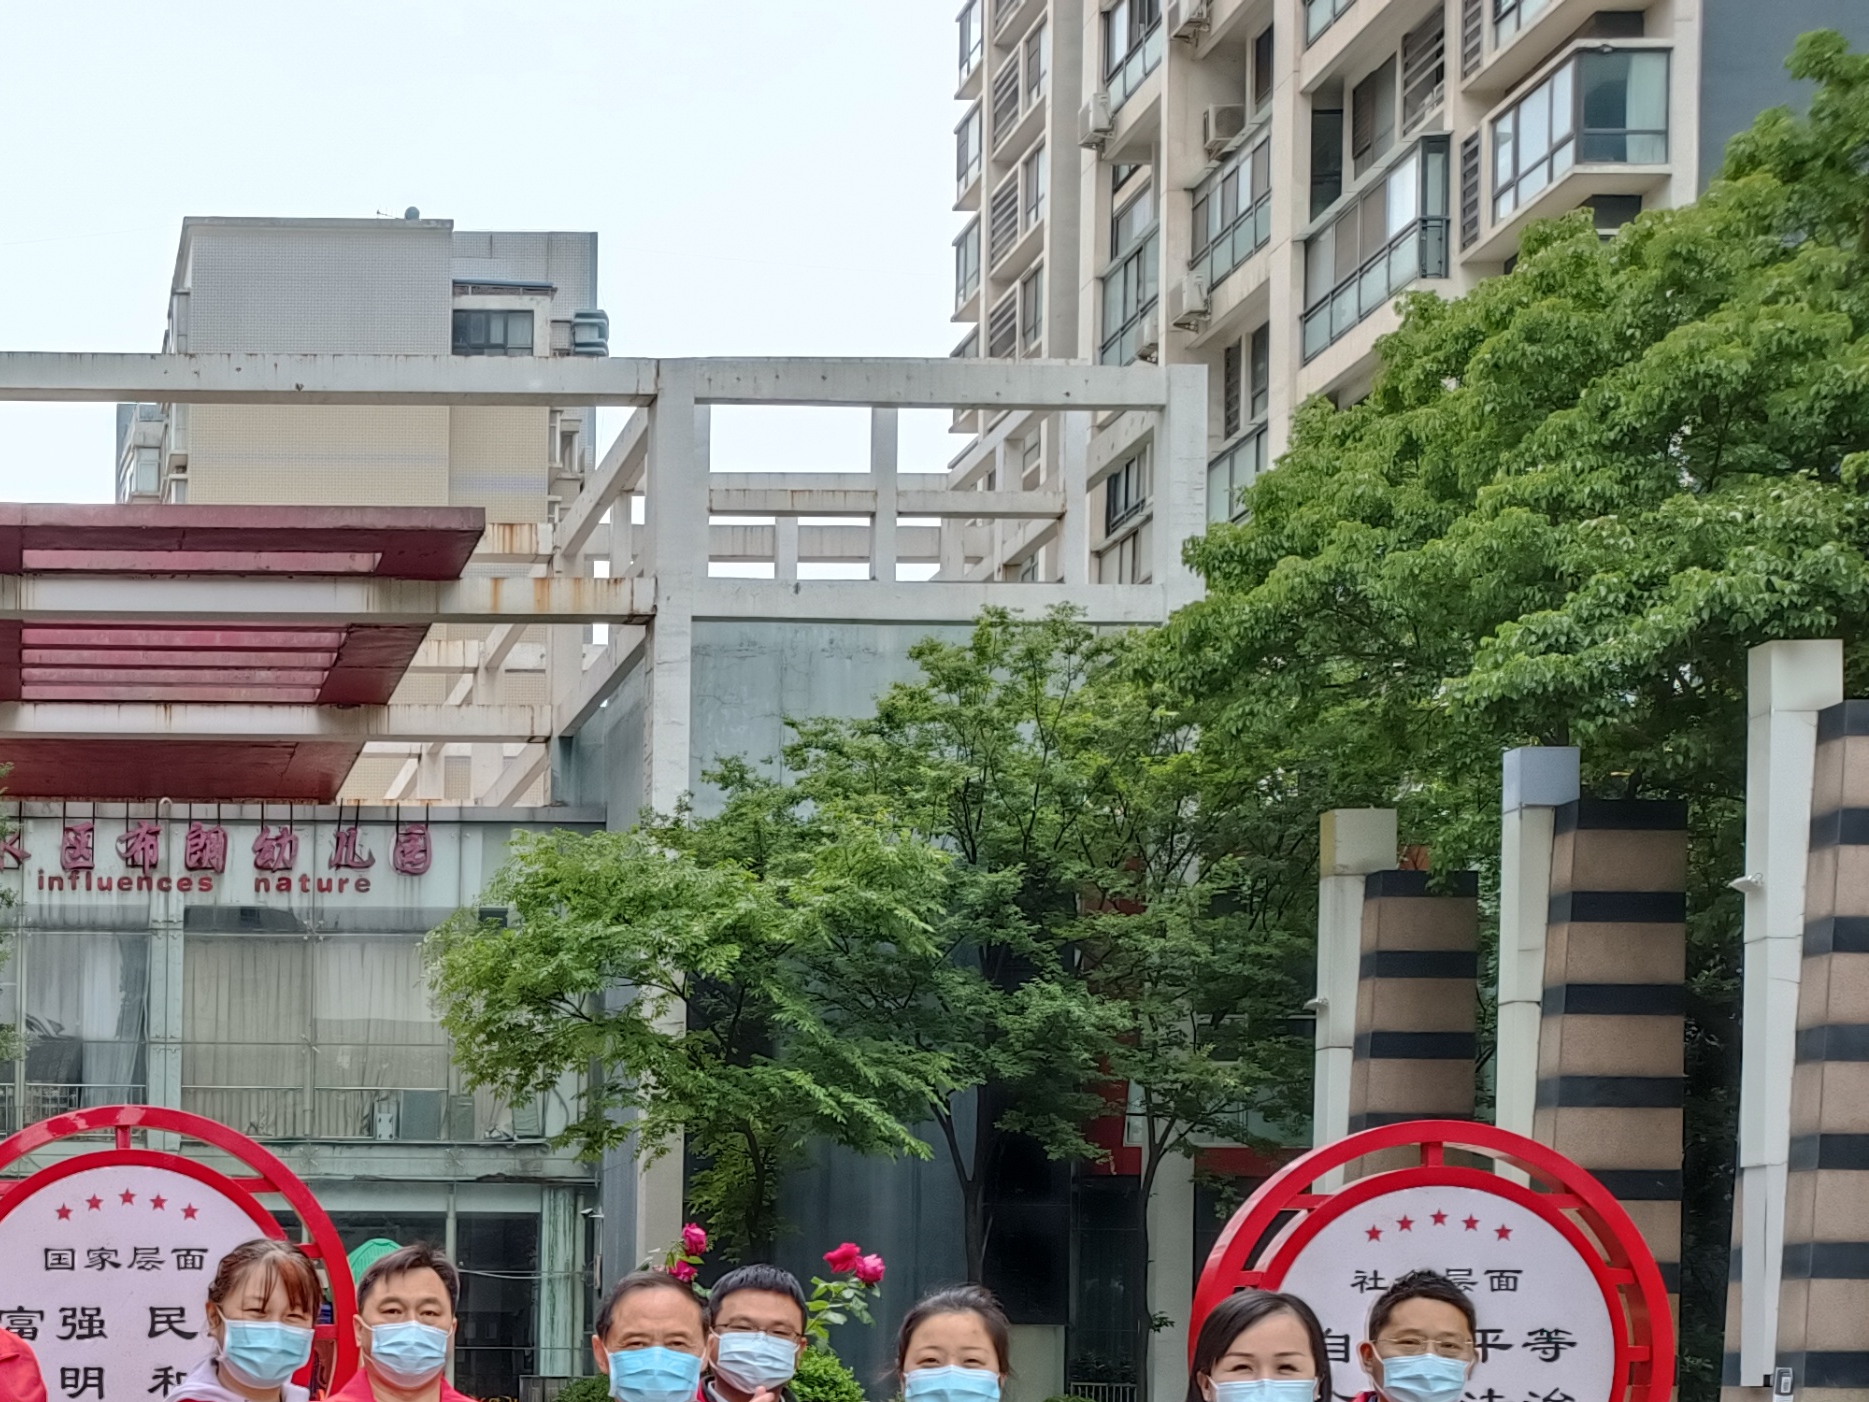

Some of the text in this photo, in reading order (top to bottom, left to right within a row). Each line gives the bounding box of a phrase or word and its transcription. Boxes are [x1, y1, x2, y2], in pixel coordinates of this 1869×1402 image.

[37, 869, 215, 893] influences
[254, 873, 371, 894] nature
[44, 1246, 209, 1272] 国家层面
